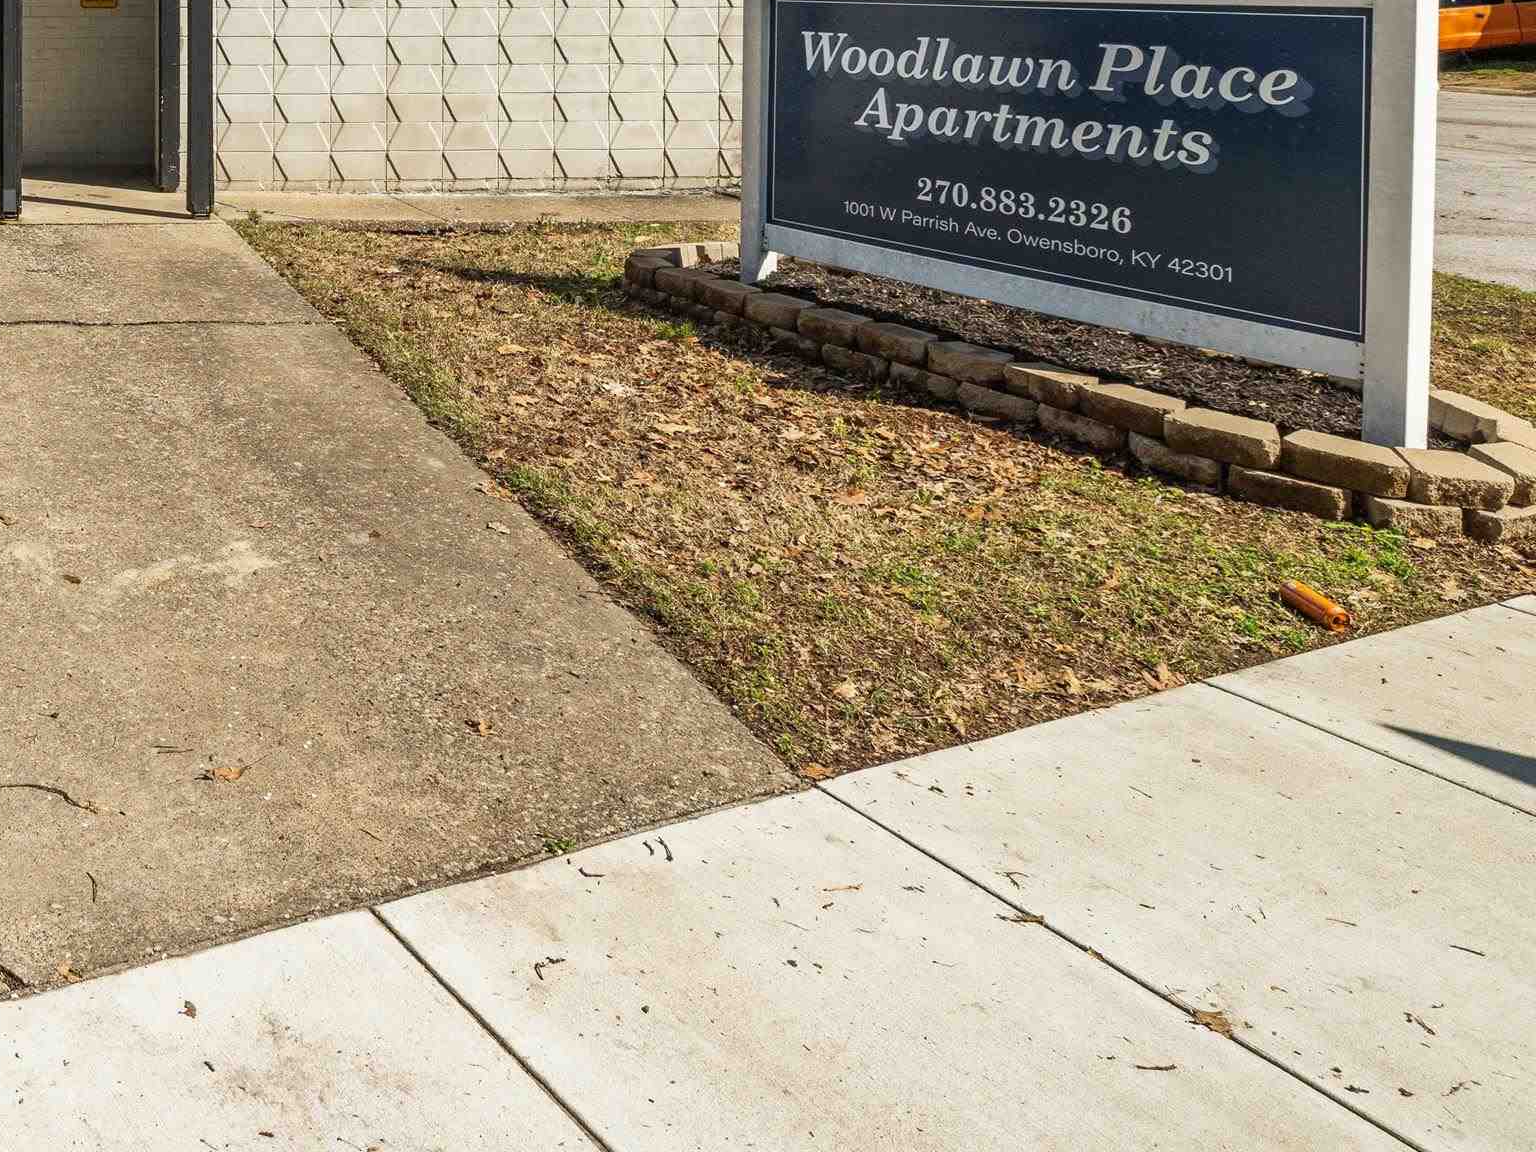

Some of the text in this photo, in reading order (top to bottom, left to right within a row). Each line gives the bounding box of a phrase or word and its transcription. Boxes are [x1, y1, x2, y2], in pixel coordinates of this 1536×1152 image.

[801, 31, 1298, 106] Woodlawn Place
[854, 87, 1212, 166] Apartments
[843, 200, 1233, 284] 1001 W Parrish Ave. Owensboro, KY 42301
[916, 177, 1132, 234] 270.883.2326
